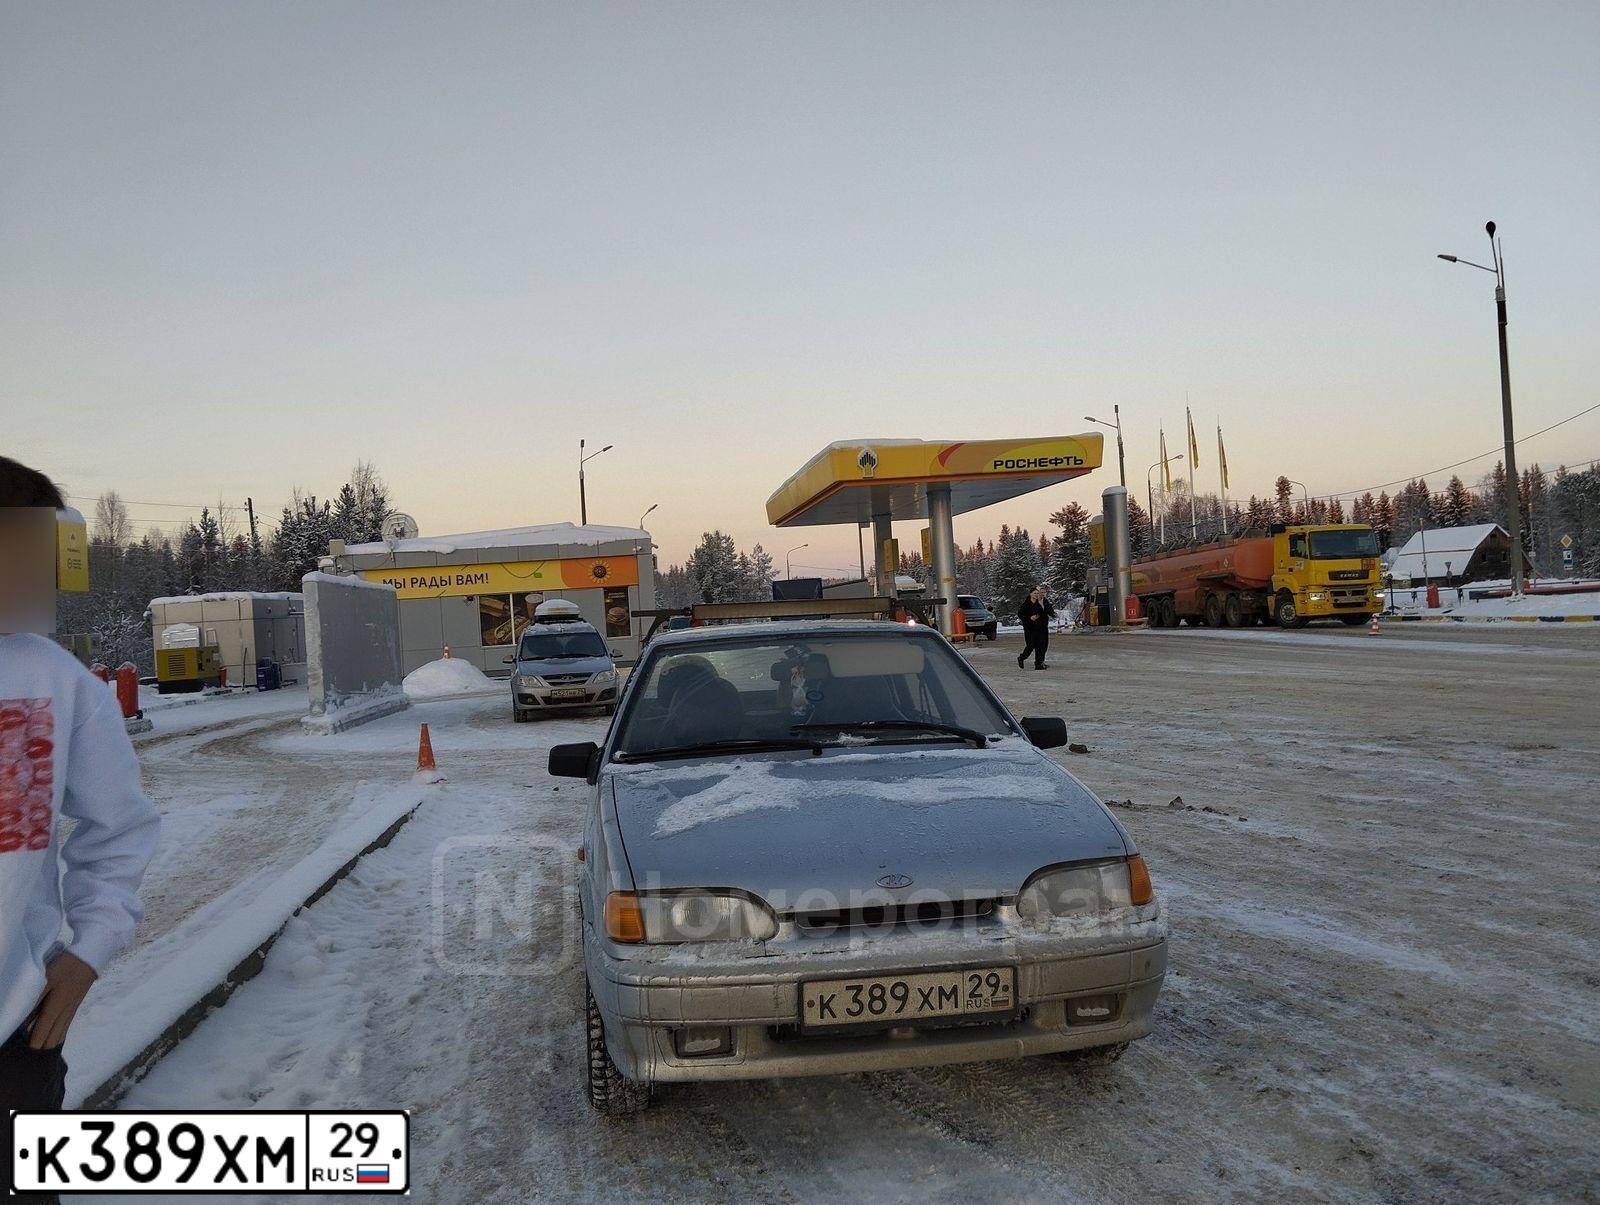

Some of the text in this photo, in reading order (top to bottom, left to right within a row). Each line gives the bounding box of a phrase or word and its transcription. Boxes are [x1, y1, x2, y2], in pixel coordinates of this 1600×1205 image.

[993, 456, 1084, 470] РОСНЕФТЬ
[410, 575, 452, 589] РАДЫ
[456, 573, 489, 586] ВАМ!
[967, 972, 1001, 998] 29
[966, 998, 990, 1009] RUS
